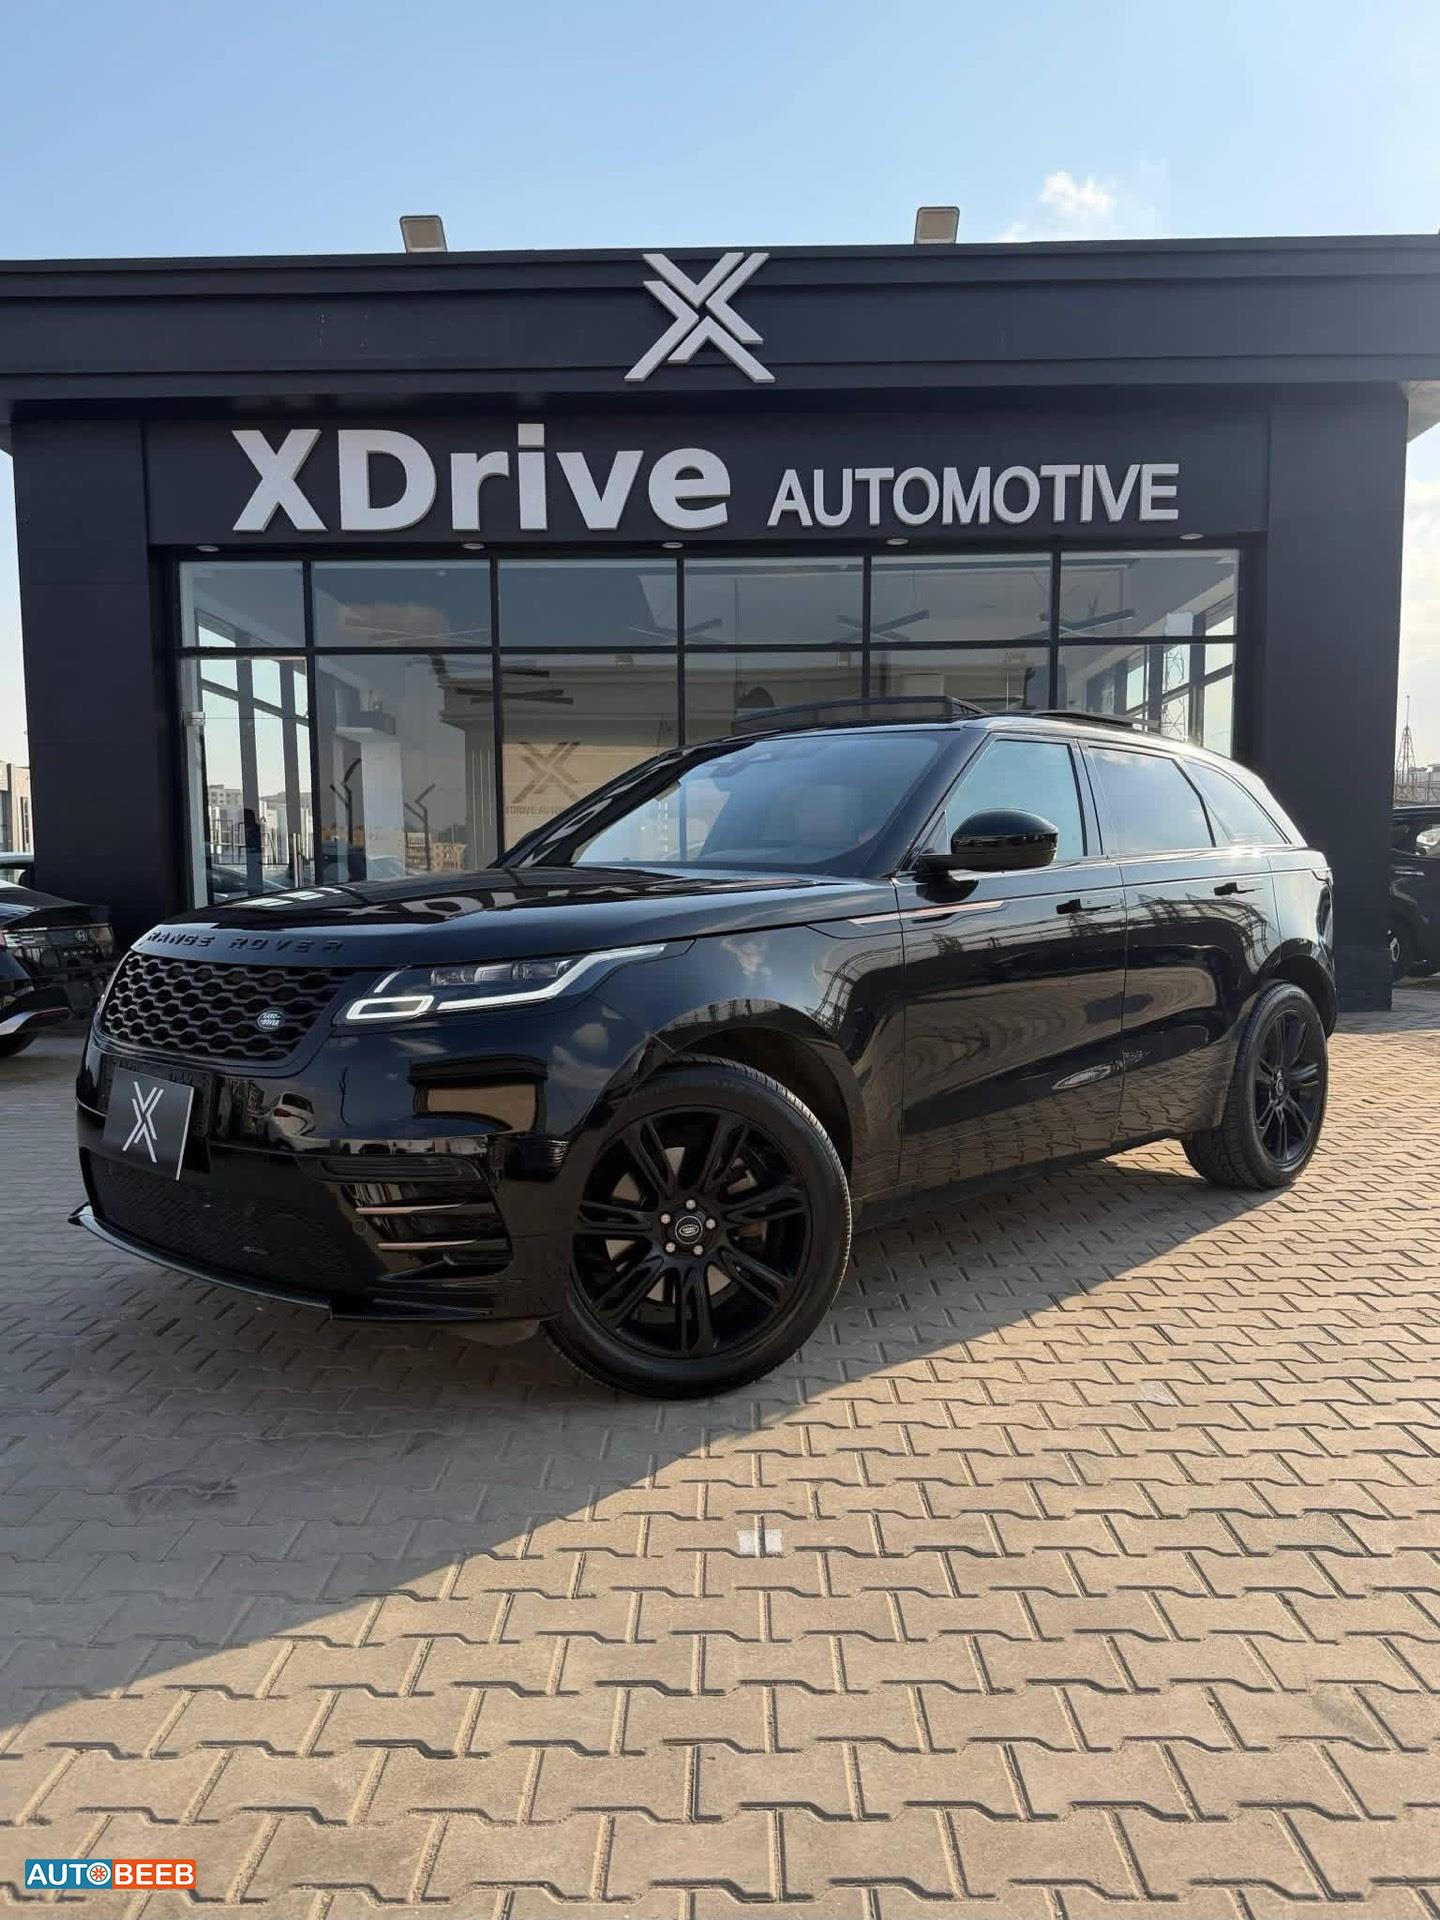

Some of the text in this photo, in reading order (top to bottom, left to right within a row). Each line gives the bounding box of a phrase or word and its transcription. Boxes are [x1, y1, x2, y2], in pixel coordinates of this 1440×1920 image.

[231, 422, 1180, 533] XDrive AUTOMOTIVE
[146, 929, 344, 954] RANGE ROVER
